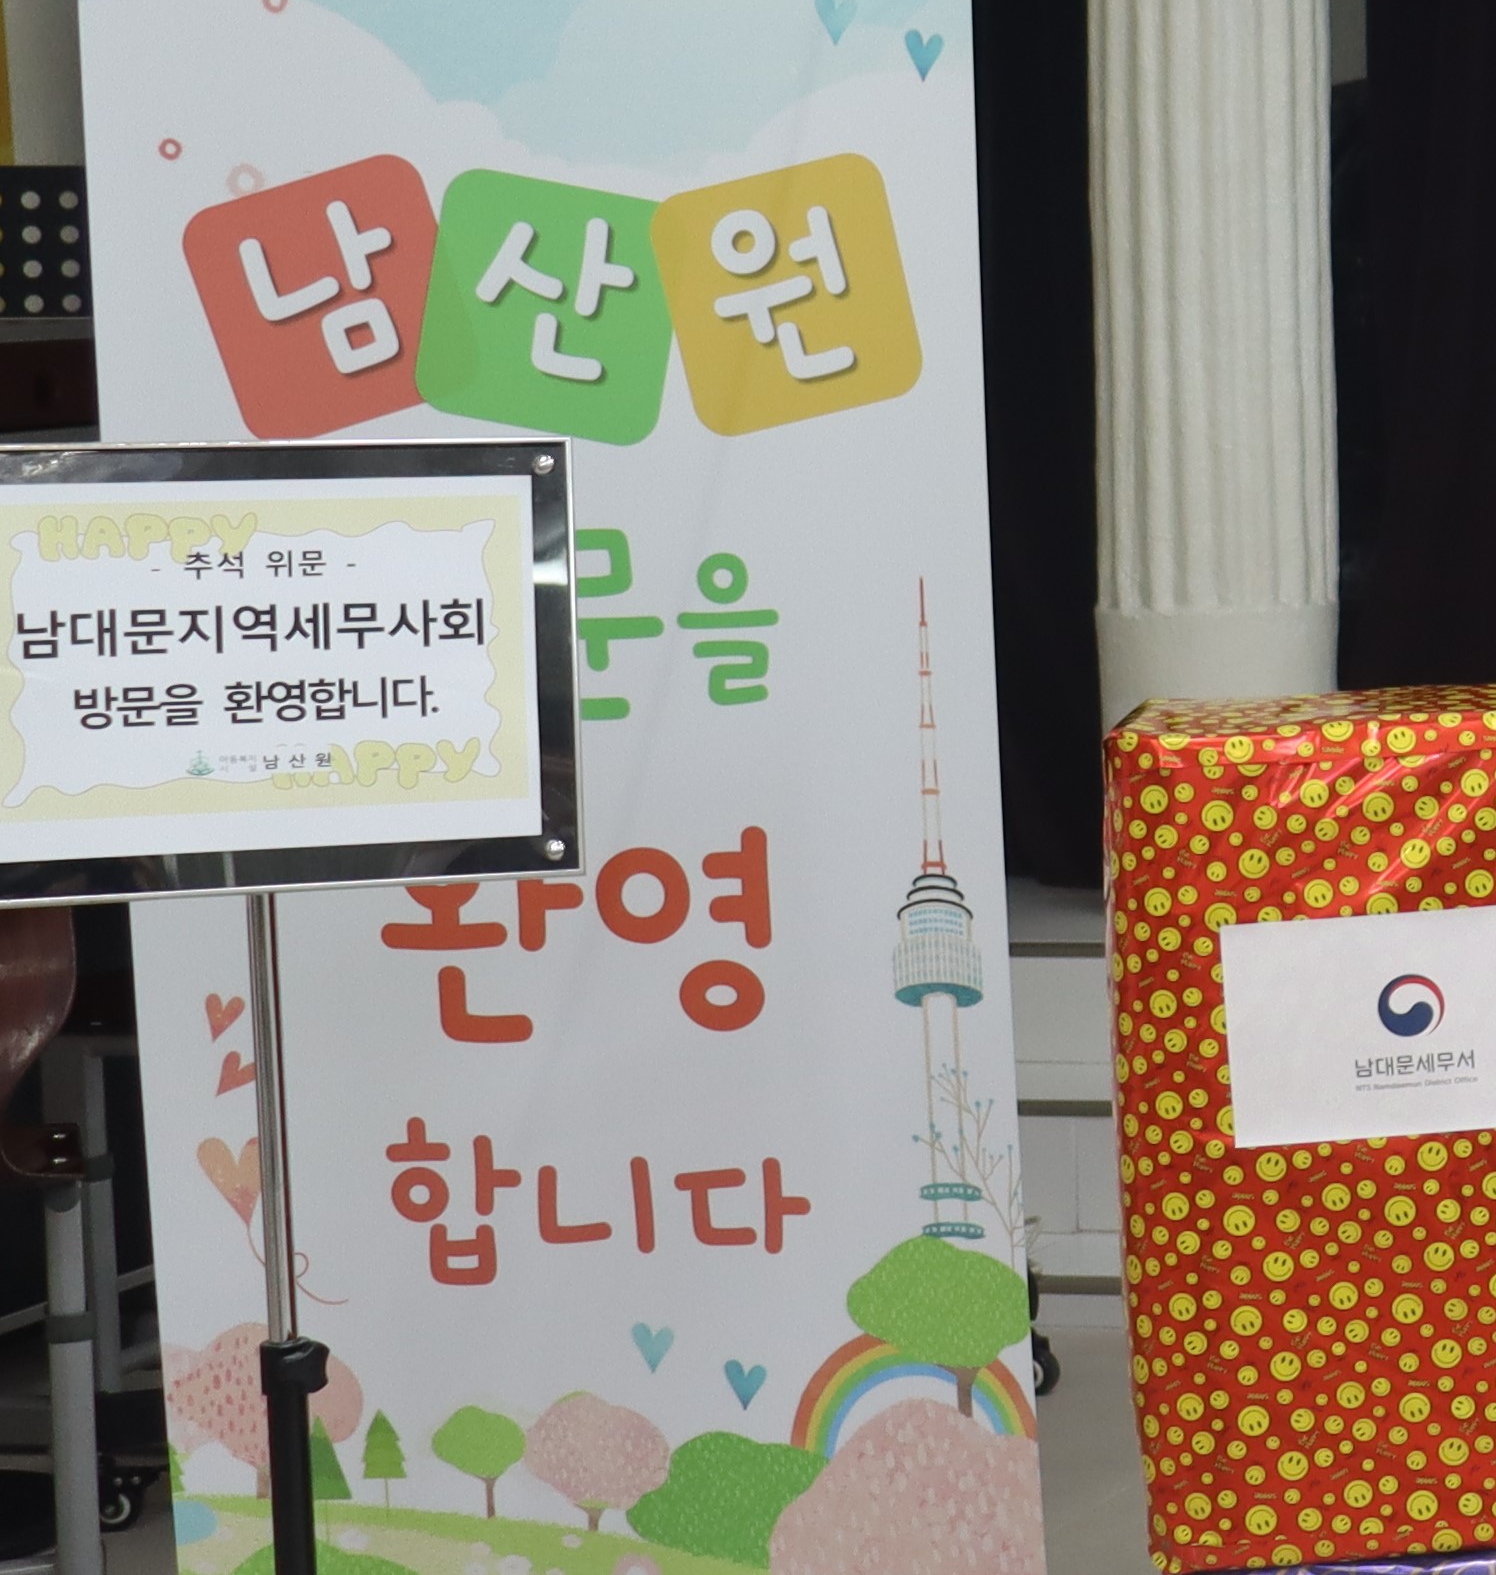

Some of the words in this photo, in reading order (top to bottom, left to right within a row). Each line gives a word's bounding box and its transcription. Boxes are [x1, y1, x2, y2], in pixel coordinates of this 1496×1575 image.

[37, 513, 258, 563] HAPPY
[185, 551, 243, 579] 추석
[266, 551, 326, 577] 위문
[17, 599, 483, 659] 남대문지역세무사회
[576, 529, 779, 720] 문을
[74, 684, 203, 729] 방문을
[224, 676, 438, 723] 환영합니다.
[271, 737, 480, 789] APPY
[1355, 1050, 1476, 1079] 남대문세무서
[385, 1116, 812, 1287] 합니다
